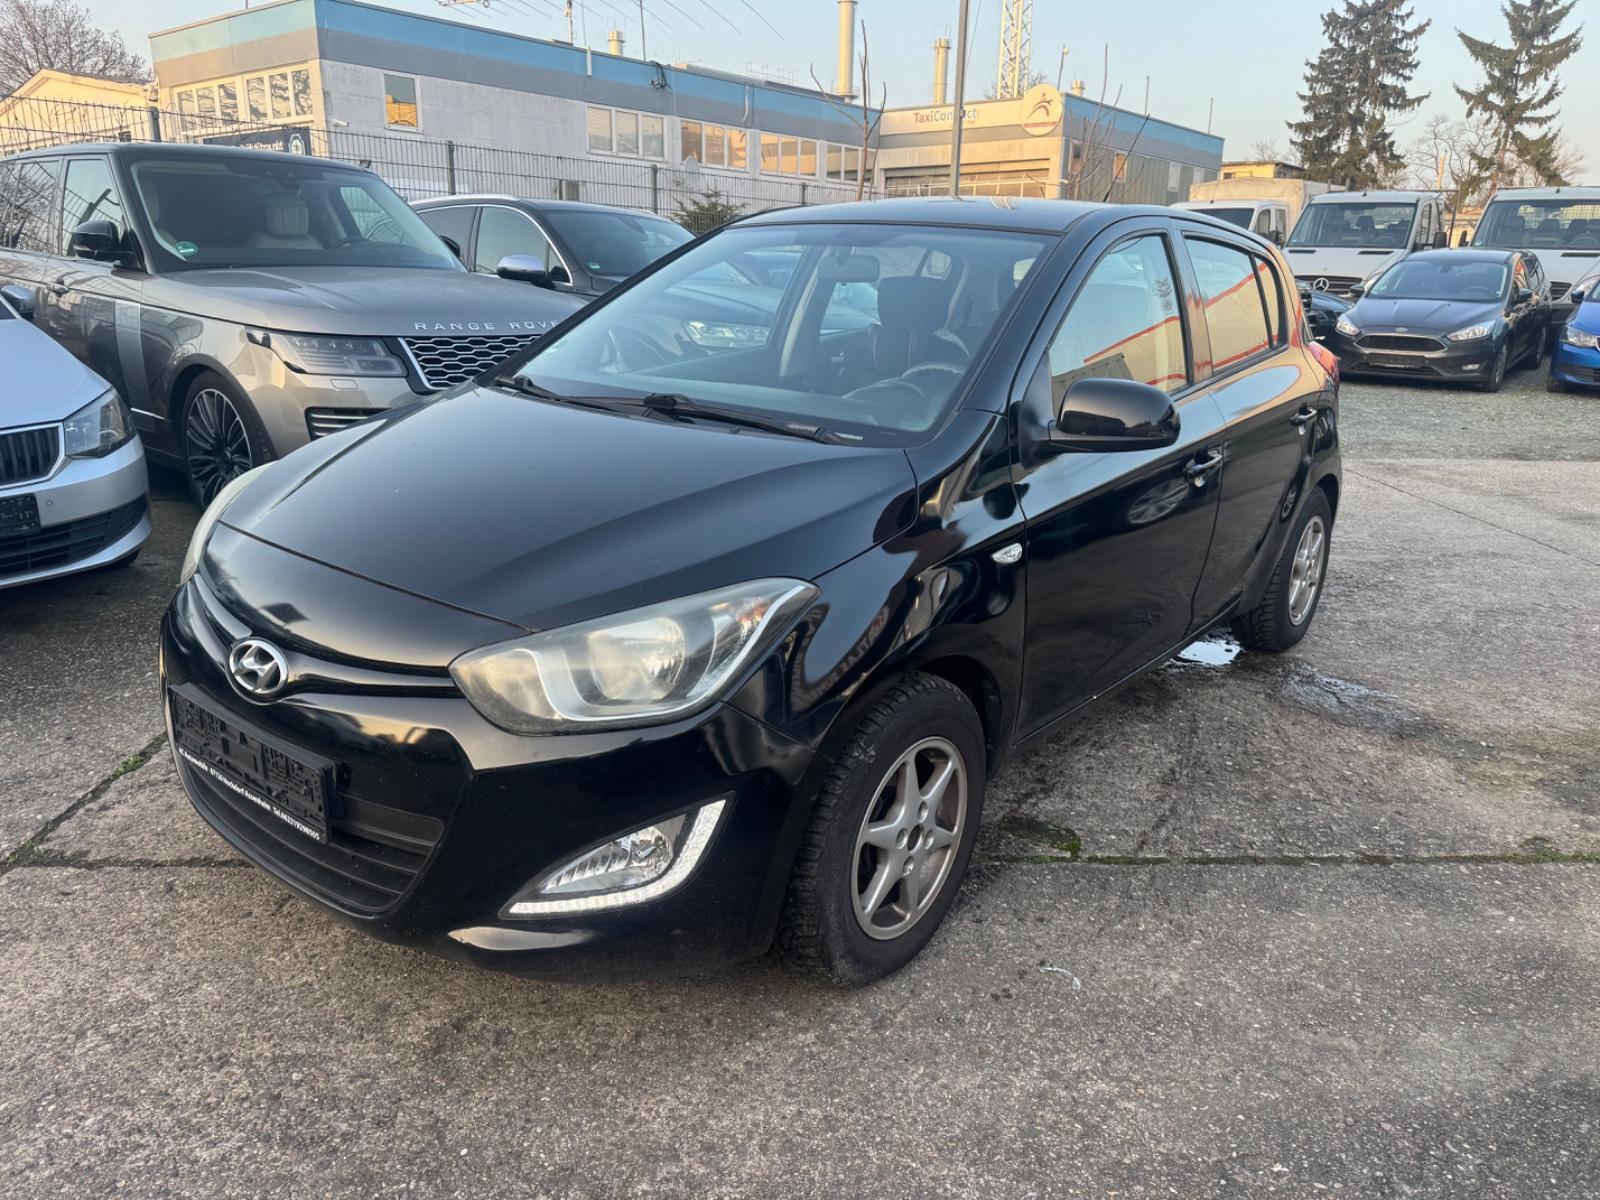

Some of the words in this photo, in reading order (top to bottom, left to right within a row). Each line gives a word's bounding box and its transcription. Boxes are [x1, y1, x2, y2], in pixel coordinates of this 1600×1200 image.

[913, 107, 977, 124] TaxiConct
[414, 322, 496, 331] RANGE
[508, 319, 560, 330] ROVE
